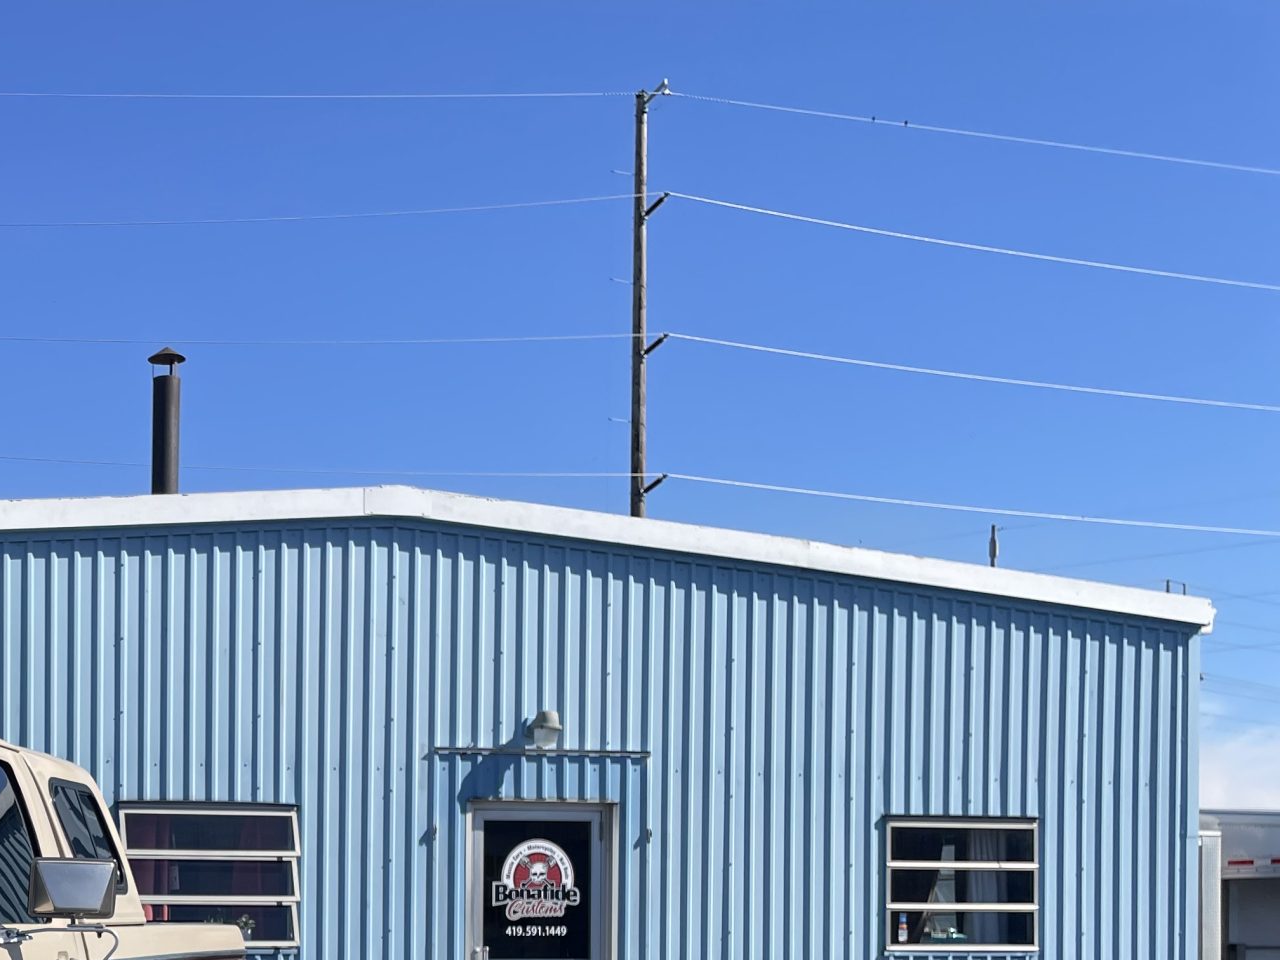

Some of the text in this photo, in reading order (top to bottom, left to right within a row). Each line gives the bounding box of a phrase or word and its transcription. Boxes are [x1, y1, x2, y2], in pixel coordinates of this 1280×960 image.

[493, 883, 579, 905] Bonafide
[506, 900, 565, 920] Customs
[505, 925, 567, 937] 419.591.1449
